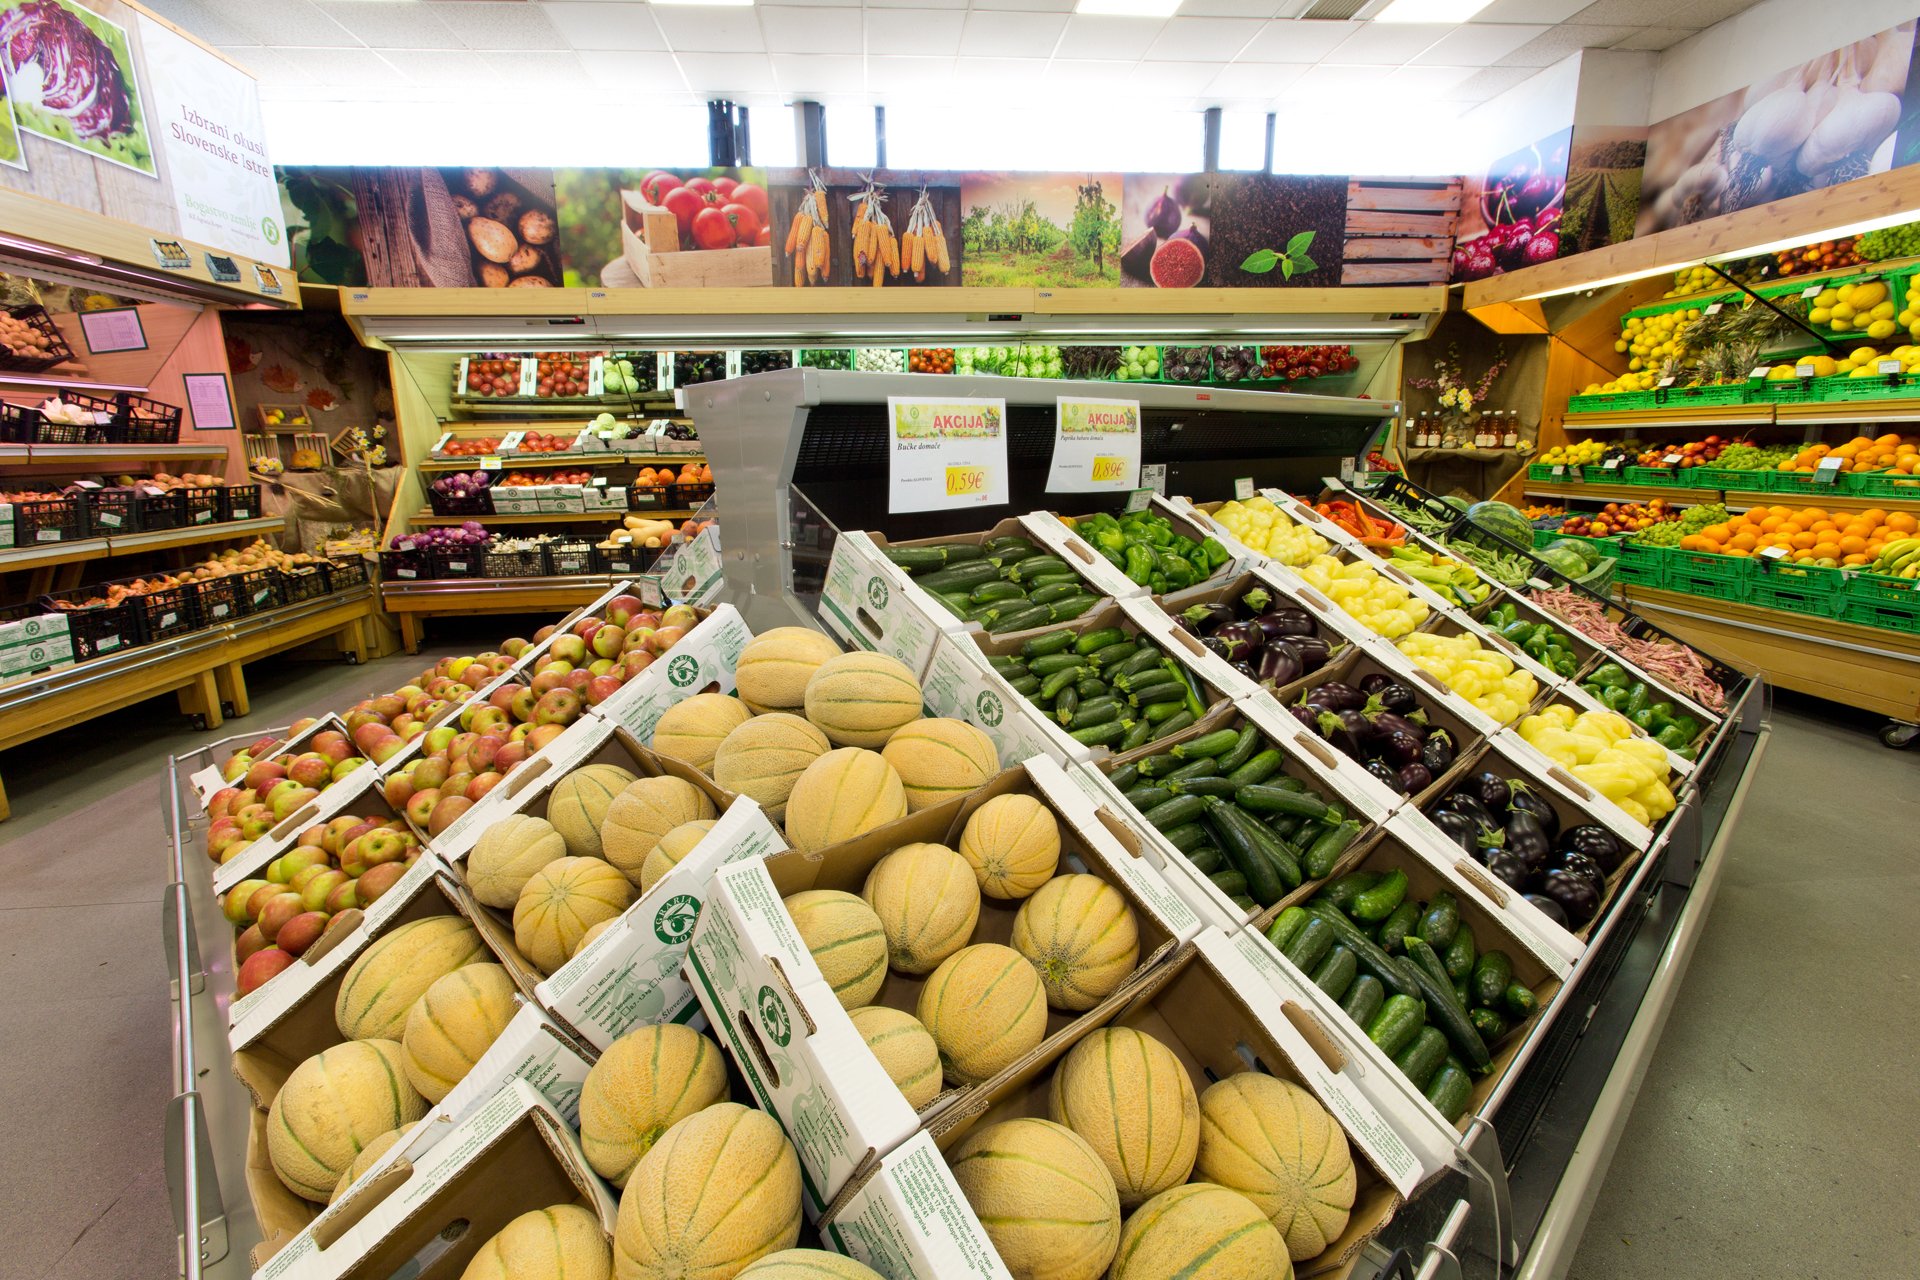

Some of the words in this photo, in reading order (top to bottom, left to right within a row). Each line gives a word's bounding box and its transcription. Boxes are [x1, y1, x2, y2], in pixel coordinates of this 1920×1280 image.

[181, 104, 230, 140] Izbrani
[233, 131, 265, 157] okusi
[171, 122, 238, 165] Slovenske
[241, 153, 269, 178] Istre
[184, 193, 229, 220] Bogastvo
[933, 415, 984, 428] AKCIJA
[1087, 413, 1125, 425] AKCIJA
[897, 442, 917, 450] Bučke
[1060, 435, 1076, 443] Paprika
[946, 472, 984, 492] 0,59€
[1093, 462, 1124, 480] 0,89€
[740, 831, 756, 845] KUMARE
[656, 895, 692, 932] AGRARIA
[576, 995, 589, 1006] Vrsta:
[596, 969, 616, 986] MELONE
[591, 1004, 608, 1019] Razred:
[614, 992, 634, 1010] Slovenija
[659, 988, 693, 1018] Sloveniji
[764, 987, 791, 1034] AGRARIA
[604, 1016, 623, 1033] Velikost:
[759, 1005, 784, 1046] KOPER
[514, 1054, 536, 1074] KUMARE
[523, 1063, 541, 1080] BUČKE
[531, 1062, 557, 1086] JAJČEVEC
[727, 1028, 754, 1073] Bogastvo
[752, 1076, 772, 1108] zemlje
[540, 1072, 562, 1093] PAPRIKA
[830, 1118, 842, 1139] BUČKE
[834, 1112, 848, 1136] KUMARE
[914, 1150, 934, 1182] Cooperativa
[932, 1182, 947, 1205] agricola
[945, 1205, 959, 1226] Agraria
[957, 1226, 970, 1245] Koper,
[920, 1146, 937, 1172] Kmetijska
[935, 1172, 950, 1194] zadruga
[947, 1194, 962, 1215] Agraria
[959, 1215, 973, 1234] Koper,
[981, 1252, 993, 1270] Koper
[908, 1154, 919, 1168] Ulica
[921, 1178, 931, 1191] maja
[946, 1222, 960, 1242] Koper,
[957, 1242, 976, 1269] Slovenija
[896, 1229, 912, 1257] MELONE
